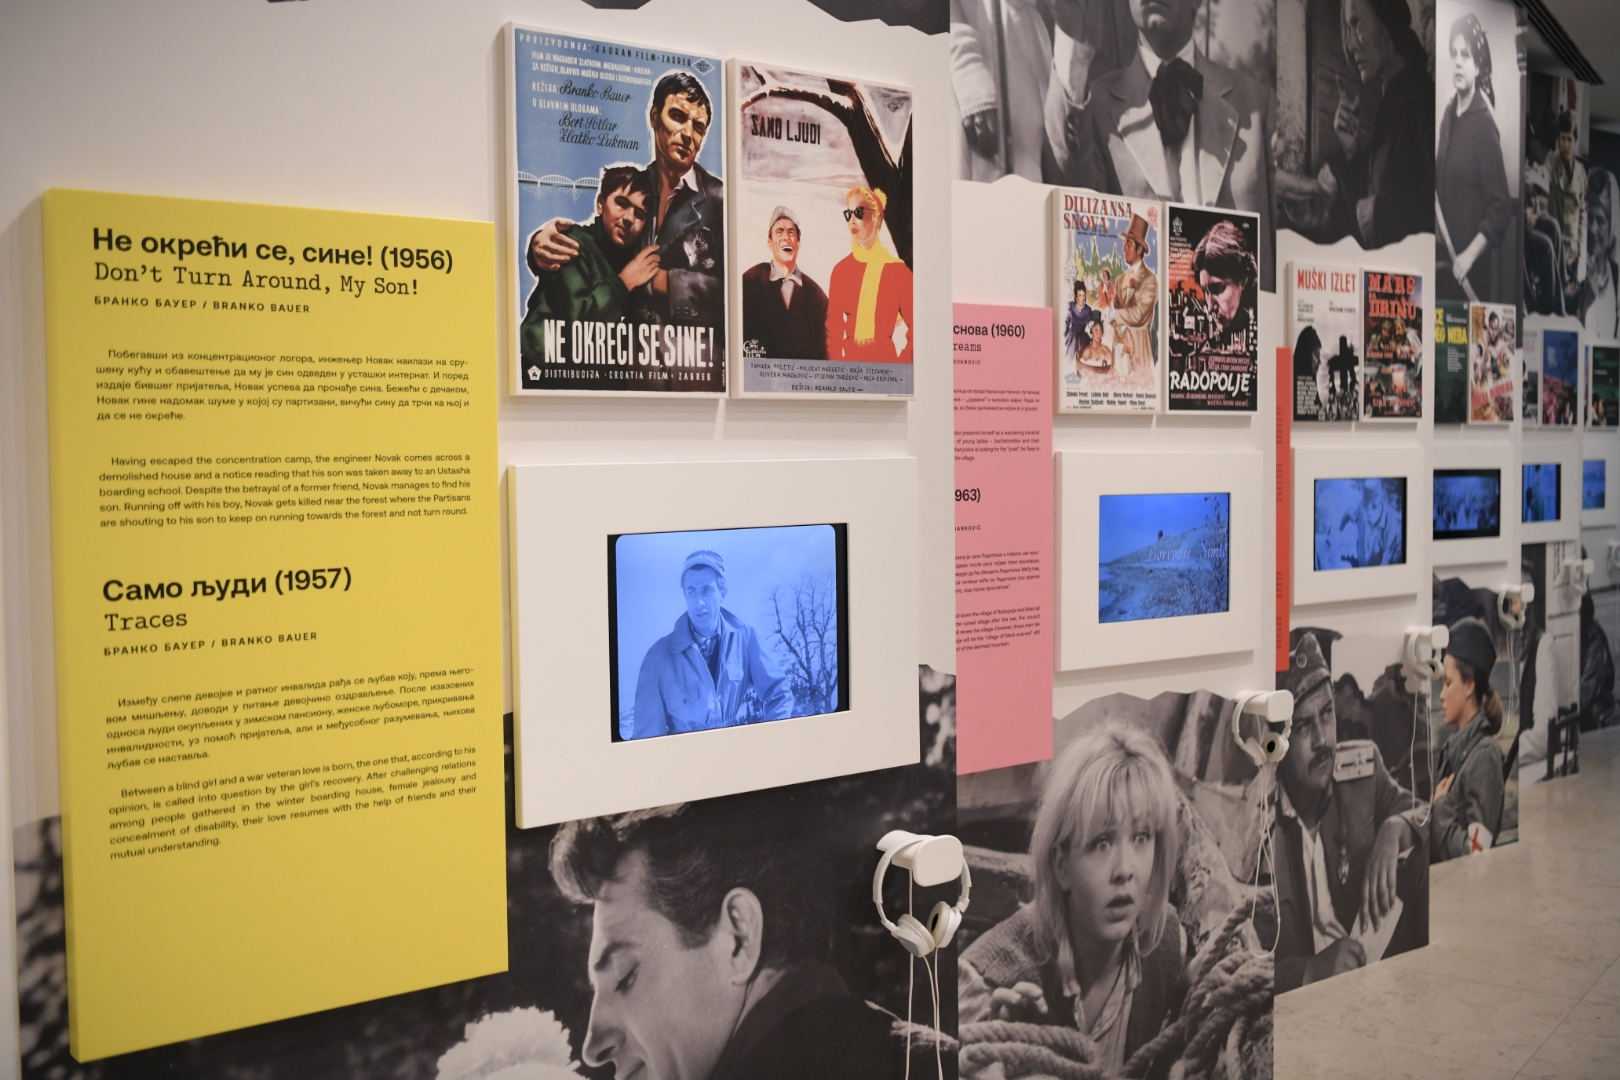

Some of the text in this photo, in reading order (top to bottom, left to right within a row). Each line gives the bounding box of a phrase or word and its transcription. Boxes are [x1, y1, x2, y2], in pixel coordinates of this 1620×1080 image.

[532, 52, 544, 60] FILM
[532, 62, 539, 70] ZA
[662, 54, 691, 66] ZAGREB
[532, 79, 633, 102] REŽIJA: Branko Bauer
[532, 98, 602, 115] U GLAVNIM ULOGAMA:
[559, 111, 619, 132] Bert Sotlar
[752, 114, 821, 145] SAMO LJUDI
[559, 128, 641, 150] Zlatko Lukman
[1064, 213, 1107, 233] SNOVA
[93, 226, 453, 274] Не окрећи се, сине! (1956)
[94, 261, 417, 298] Don’t Turn Around, My Son!
[1298, 267, 1356, 293] MUŠKI IZLET
[94, 295, 149, 307] БРАНКО
[155, 298, 197, 309] БАУЕР
[213, 300, 265, 311] BRANKO
[270, 303, 309, 313] BAUER
[991, 323, 1025, 339] (1960)
[1448, 327, 1468, 345] NEBA
[544, 319, 566, 363] NE
[572, 316, 633, 365] OKREĆI
[664, 324, 714, 367] SINE!
[108, 348, 168, 360] Побегавши
[171, 352, 184, 361] из
[187, 353, 276, 363] концентрационог
[279, 355, 315, 364] логора,
[318, 356, 363, 365] инжењер
[365, 355, 393, 364] Новак
[396, 358, 433, 366] наилази
[449, 359, 468, 368] сру-
[545, 369, 711, 381] DISTRIBUCIJA CROATIA FILM ZAGREB
[1170, 371, 1250, 397] RADOPOLJE
[96, 379, 132, 392] издаје
[134, 379, 173, 390] бившег
[176, 381, 232, 392] пријатеља,
[234, 381, 265, 391] Новак
[267, 384, 301, 393] успева
[302, 384, 315, 393] да
[317, 383, 357, 394] пронађе
[386, 383, 420, 393] Бежећи
[429, 386, 469, 394] дечаком,
[110, 456, 146, 468] Having
[149, 455, 193, 467] escaped
[195, 455, 212, 465] the
[215, 455, 282, 465] concentration
[284, 456, 313, 465] camp,
[315, 454, 330, 463] the
[333, 454, 372, 465] engineer
[374, 453, 401, 462] Novak
[403, 454, 433, 462] comes
[955, 488, 981, 503] 963)
[102, 566, 351, 602] Само људи (1957)
[104, 613, 187, 632] Traces
[103, 643, 158, 657] БРАНКО
[164, 640, 205, 652] БАУЕР
[221, 635, 272, 647] BRANKO
[278, 631, 317, 643] BAUER
[108, 760, 476, 817] opinion, is called into question by the girl’s recovery. After challenging relations
